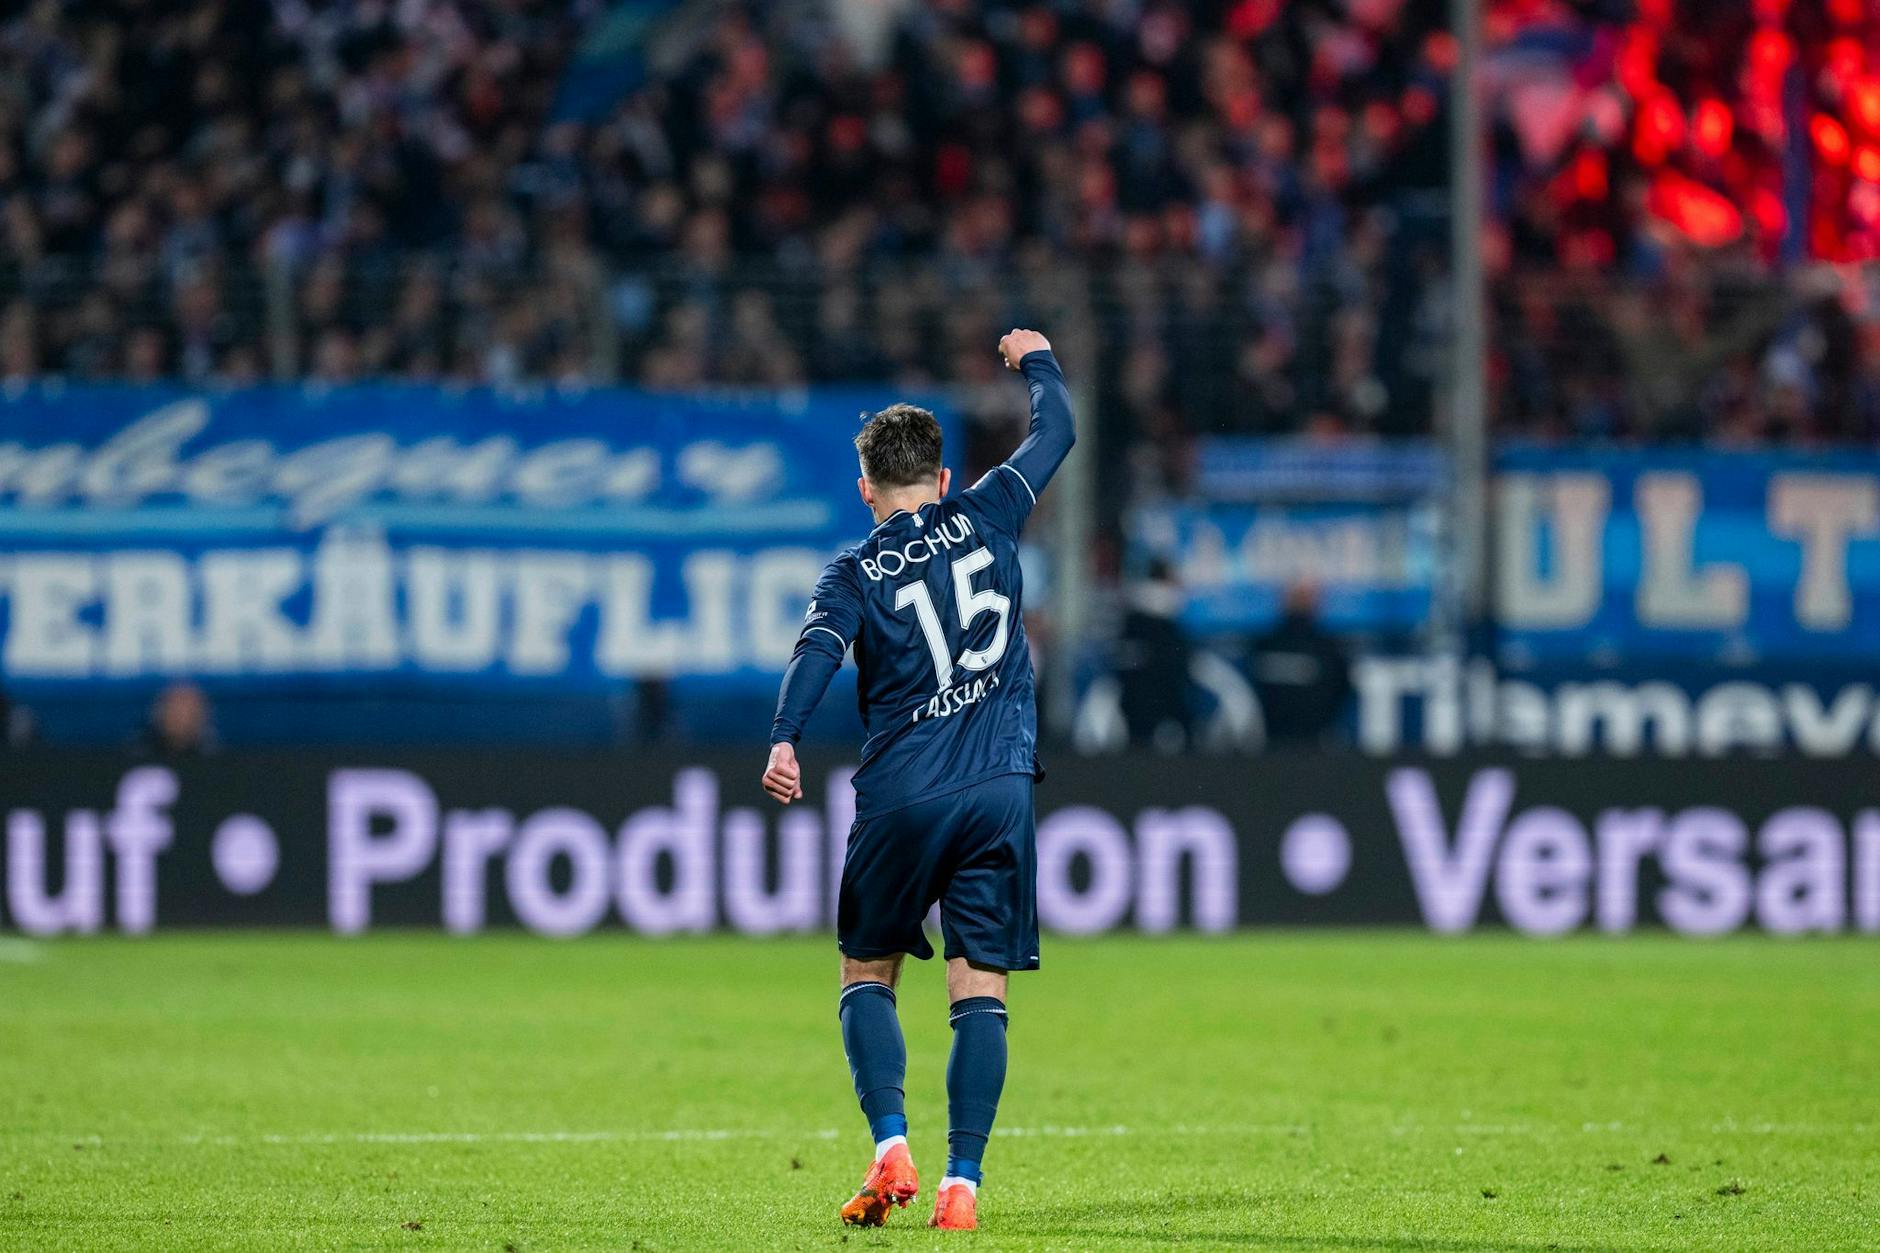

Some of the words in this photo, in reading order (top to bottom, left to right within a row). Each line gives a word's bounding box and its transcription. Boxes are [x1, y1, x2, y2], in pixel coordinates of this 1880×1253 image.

[0, 525, 860, 676] ERKÄUFLIC
[895, 546, 1011, 694] 15
[1494, 470, 1877, 629] ULT
[6, 765, 179, 935] uf
[325, 768, 1237, 936] Produon
